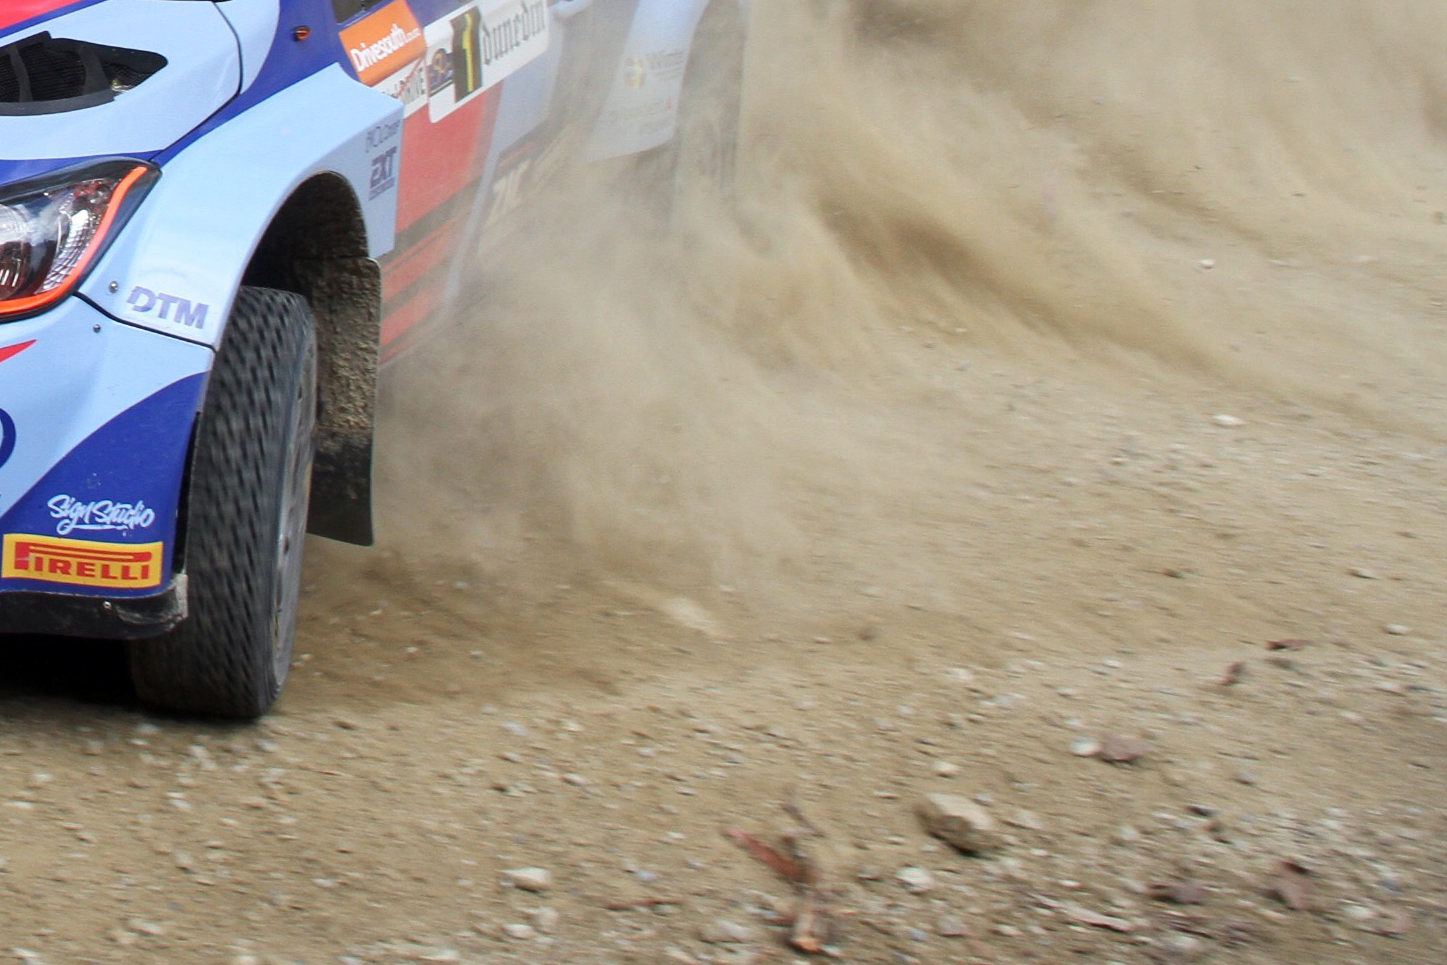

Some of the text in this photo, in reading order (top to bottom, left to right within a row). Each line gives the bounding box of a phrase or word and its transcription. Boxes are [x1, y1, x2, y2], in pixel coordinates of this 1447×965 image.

[462, 13, 476, 93] 1
[127, 286, 210, 329] DTM
[14, 540, 152, 580] PIRELLI
